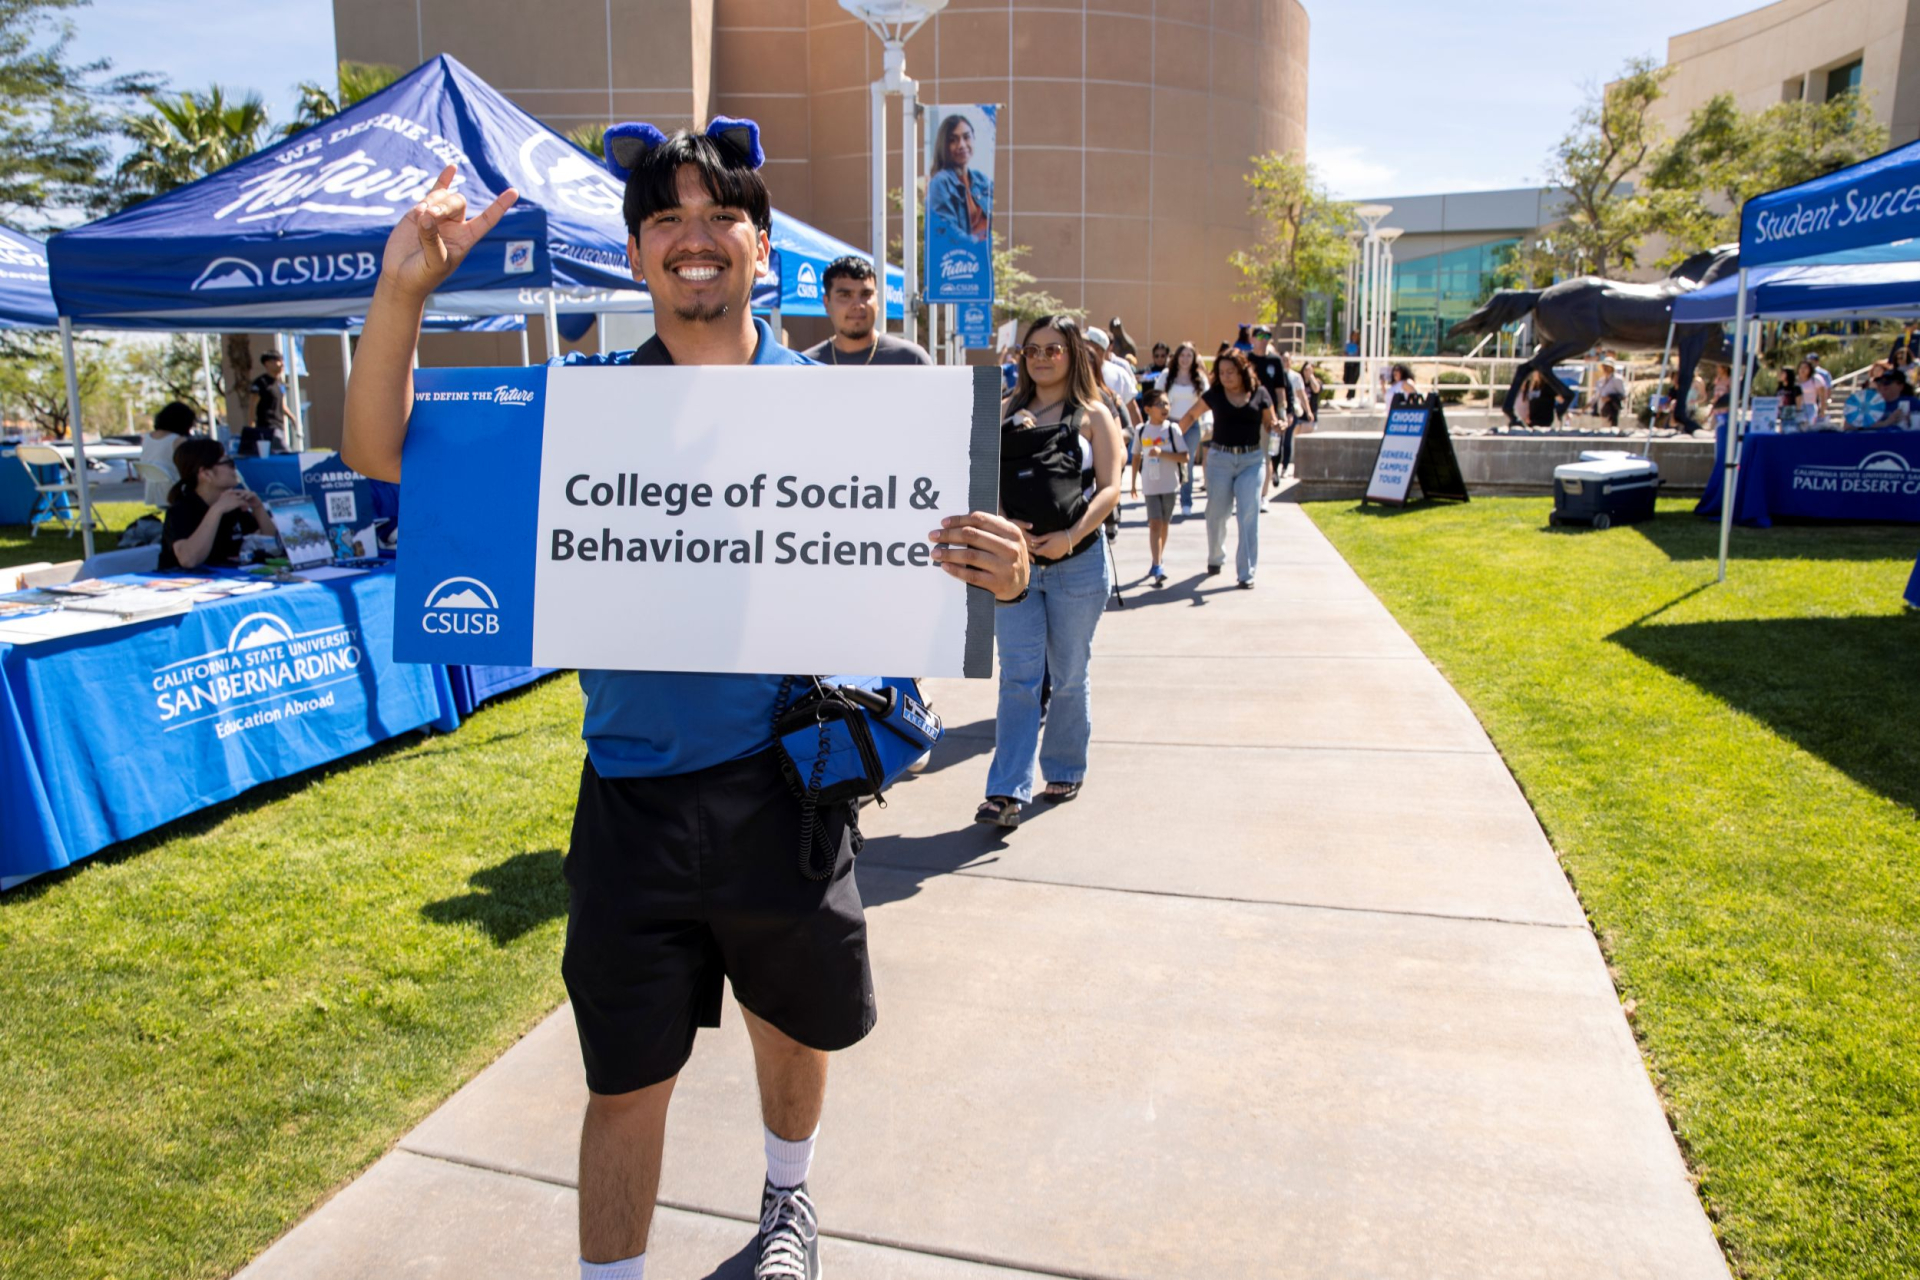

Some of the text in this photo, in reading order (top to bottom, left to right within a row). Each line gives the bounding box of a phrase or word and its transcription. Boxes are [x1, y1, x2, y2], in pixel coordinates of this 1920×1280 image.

[276, 113, 470, 166] WE DEFINE THE
[214, 150, 467, 222] Future
[1755, 198, 1839, 244] Student
[270, 252, 377, 286] CSUSB
[940, 259, 979, 280] Future
[797, 281, 818, 299] CSUSB
[415, 385, 534, 405] WE DEFINE THE Future
[1392, 411, 1425, 423] CHOOSE
[1379, 462, 1410, 473] CAMPUS
[1381, 450, 1413, 461] GENERAL
[1379, 474, 1402, 485] TOURS
[1793, 476, 1837, 492] PALM
[1841, 479, 1900, 494] DESERT
[566, 473, 940, 516] College of Social &
[551, 527, 764, 564] Behavioral
[422, 612, 500, 635] CSUSB
[153, 629, 358, 692] CALIFORNIA STATE UNIVERSITY
[215, 691, 335, 739] Education Abroad
[906, 711, 937, 738] ANCHOR
